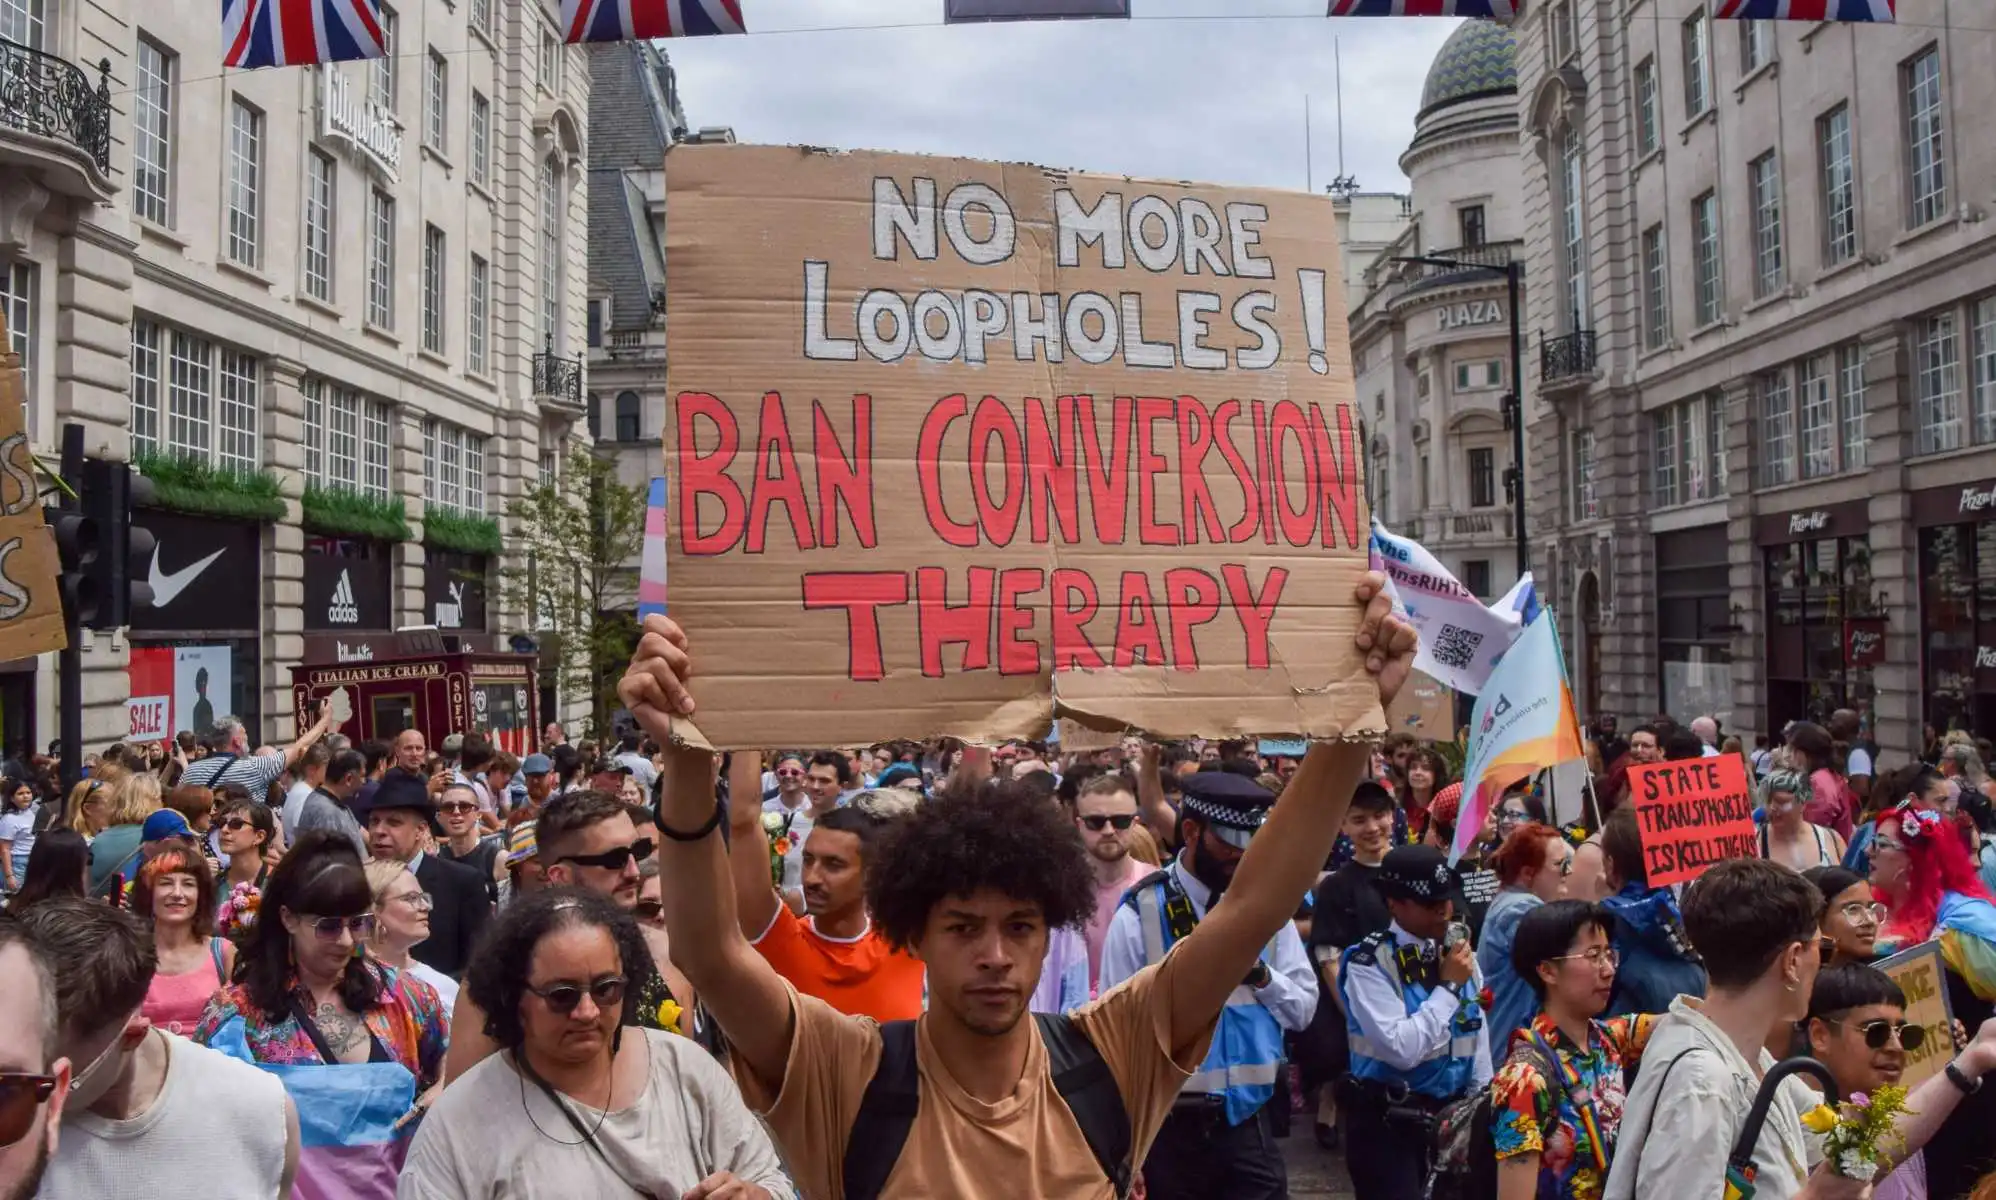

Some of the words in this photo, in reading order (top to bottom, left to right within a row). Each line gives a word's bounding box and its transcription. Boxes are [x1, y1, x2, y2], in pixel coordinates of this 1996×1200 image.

[872, 175, 1017, 265] NO
[1052, 187, 1277, 280] MORE
[1436, 300, 1503, 330] PLAZA
[673, 390, 879, 556] BAN
[915, 392, 1362, 550] CONVERSION
[328, 601, 359, 624] adidas
[801, 563, 1290, 682] THERAPY
[318, 668, 368, 683] ITALIAN
[371, 668, 392, 680] ICE
[395, 664, 440, 678] CREAM
[129, 703, 163, 736] SALE
[453, 680, 463, 726] SOFT
[1643, 763, 1721, 801] STATE
[1637, 793, 1751, 833] TRANSPHOBIA
